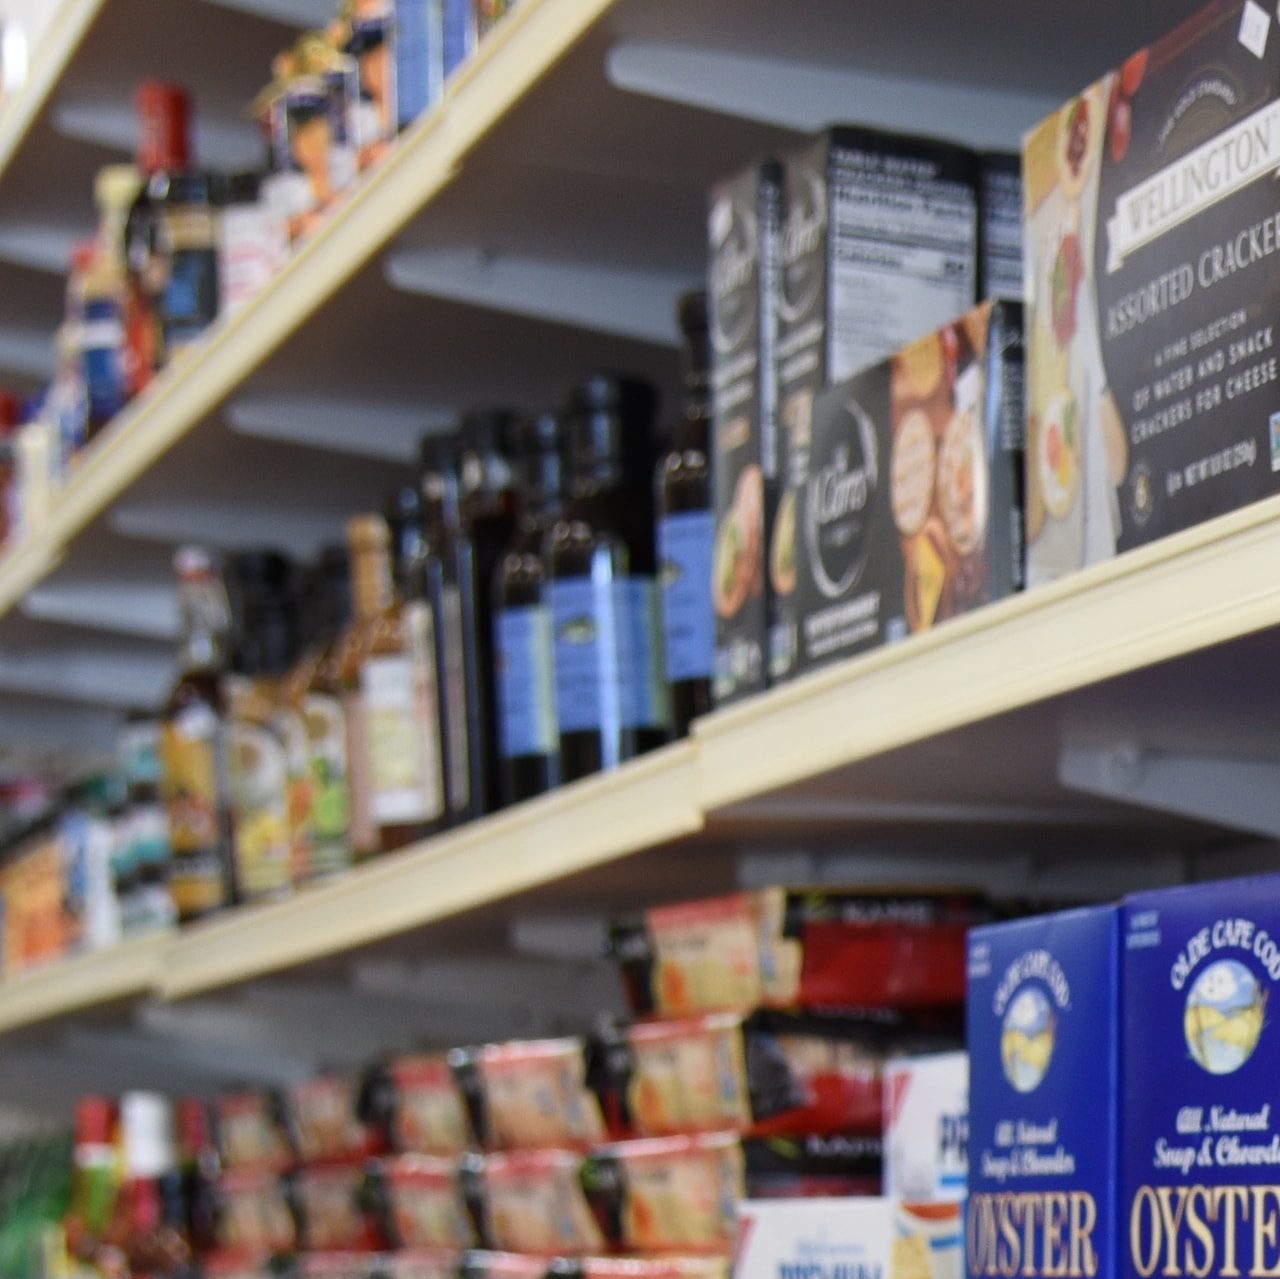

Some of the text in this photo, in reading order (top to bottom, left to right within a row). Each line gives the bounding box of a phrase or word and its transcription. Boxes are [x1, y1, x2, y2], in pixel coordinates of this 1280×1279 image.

[1127, 117, 1272, 236] WELLINGTON
[1106, 262, 1194, 340] ASSORTED
[1197, 350, 1225, 378] AND
[1228, 326, 1274, 365] SNACK
[1131, 397, 1193, 444] CRACKERS
[1225, 357, 1277, 399] CHEESE
[1170, 927, 1211, 990] OLDE
[1212, 918, 1255, 950] CAPE
[1153, 1137, 1196, 1175] Soup
[1197, 1136, 1213, 1166] &
[1204, 1103, 1270, 1133] Natural
[967, 1191, 1098, 1279] OYSTER
